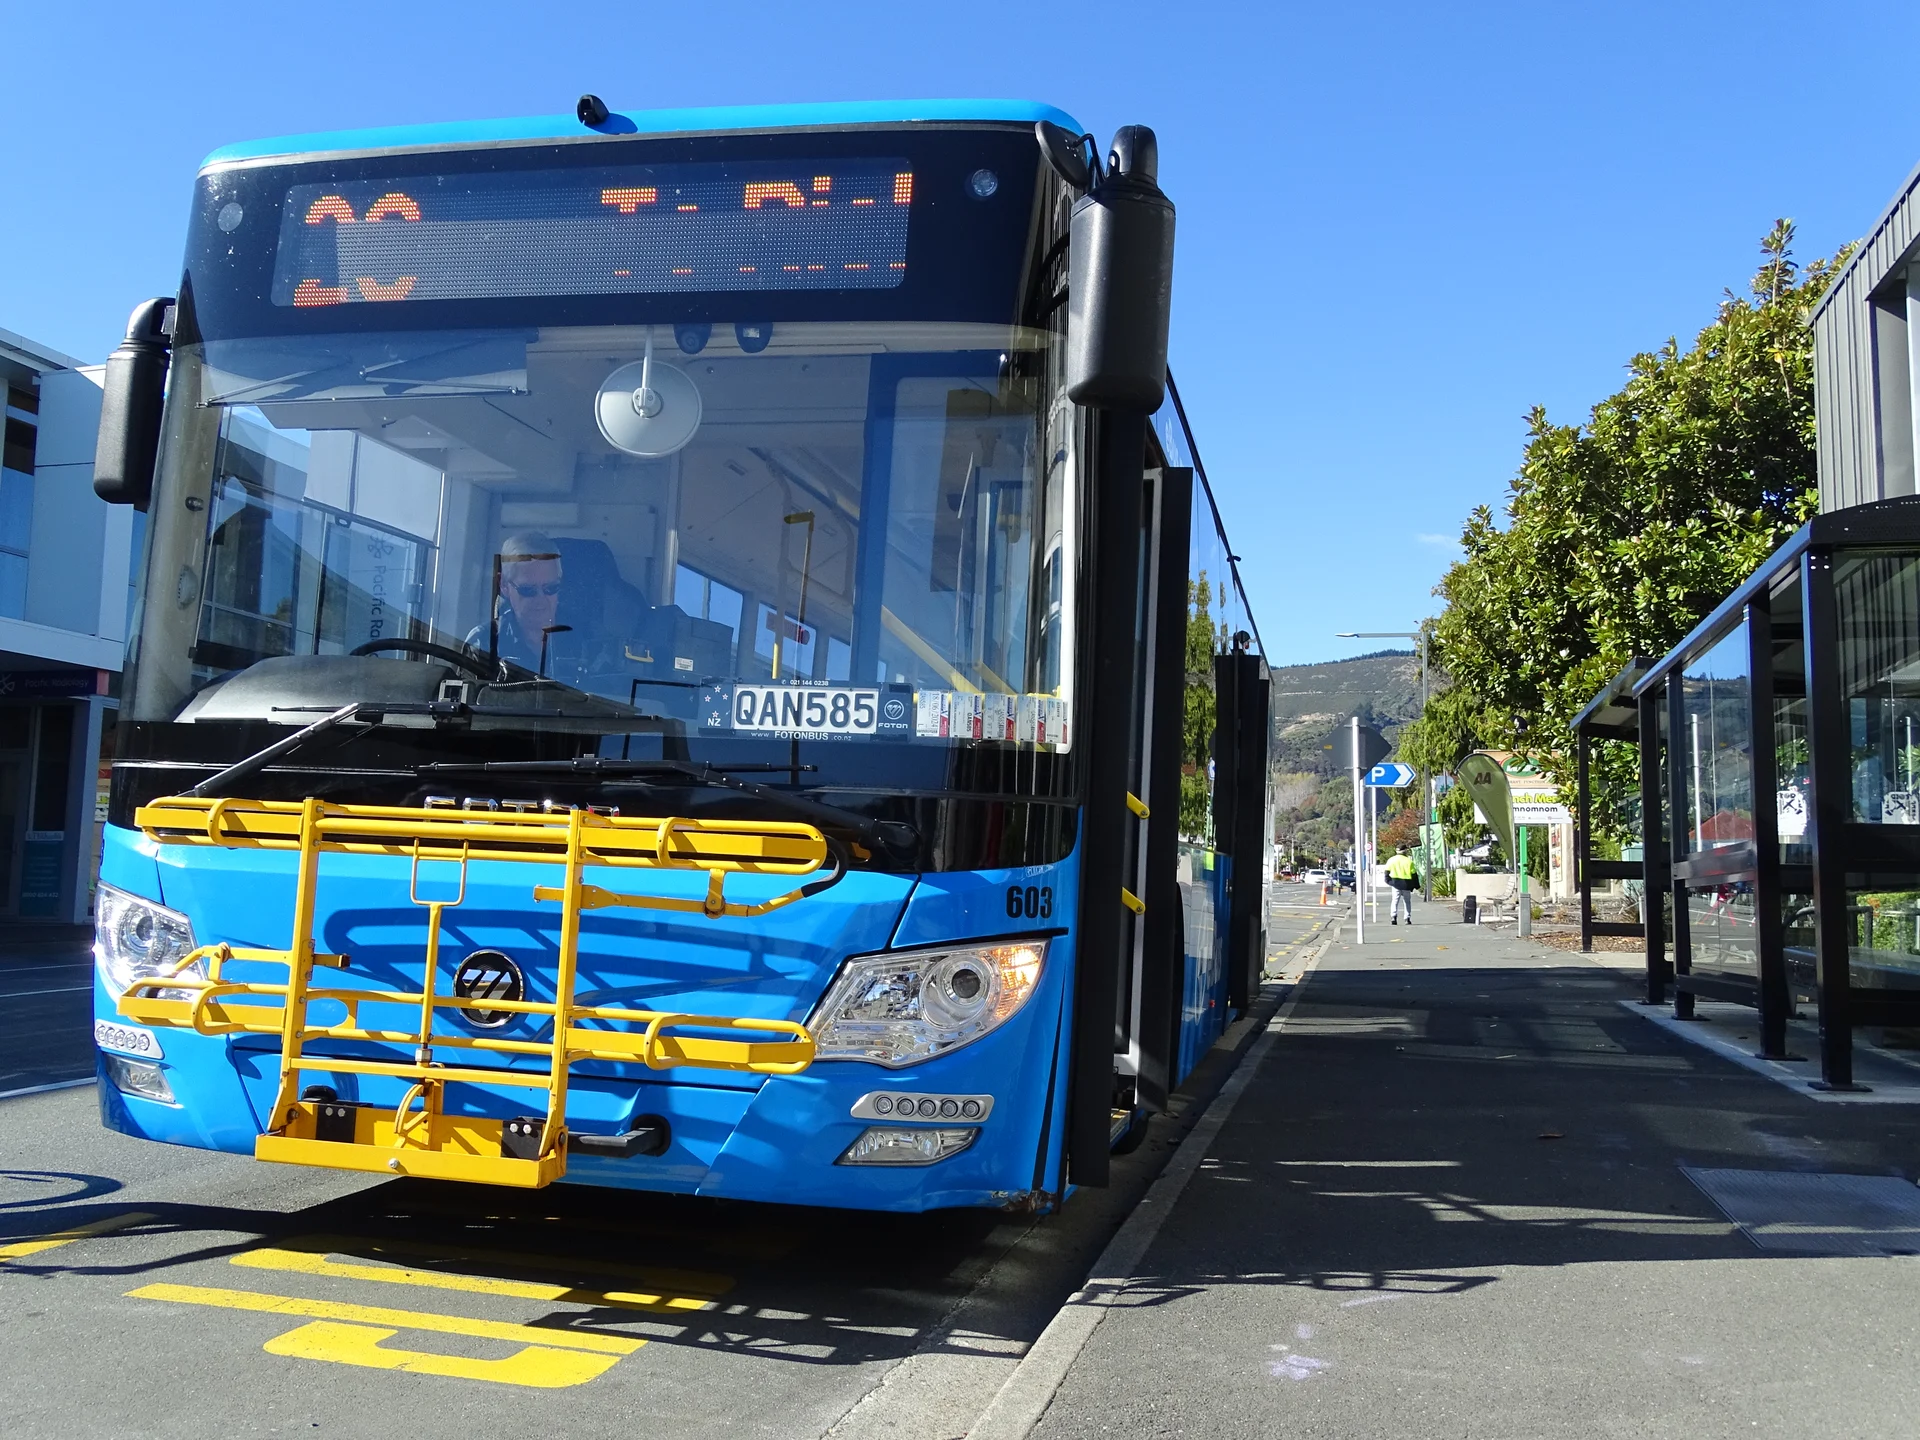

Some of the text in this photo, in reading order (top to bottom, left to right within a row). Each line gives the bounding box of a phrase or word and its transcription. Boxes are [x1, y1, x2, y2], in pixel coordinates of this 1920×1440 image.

[736, 690, 876, 729] QAN585
[707, 717, 721, 727] NZ
[774, 731, 829, 741] FOTONBUS
[1371, 767, 1386, 782] P
[1473, 772, 1492, 785] AA
[1006, 885, 1053, 919] 603
